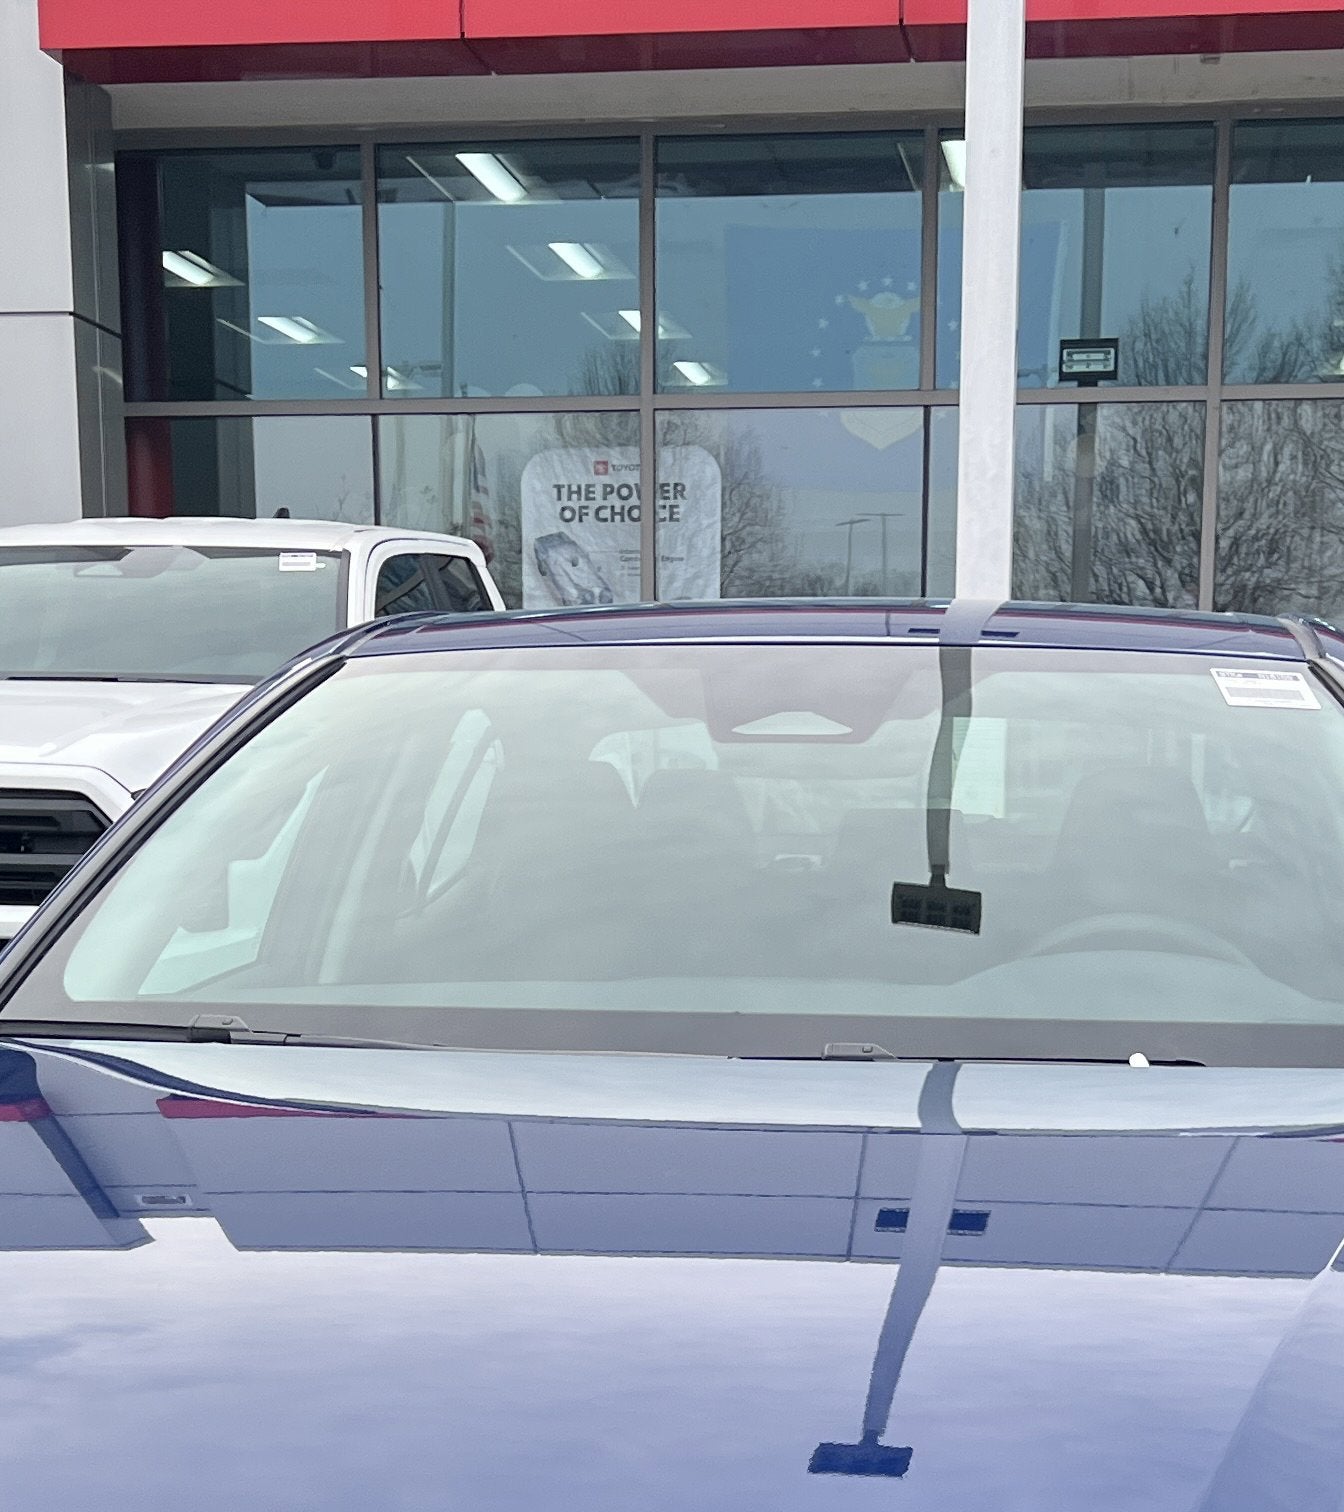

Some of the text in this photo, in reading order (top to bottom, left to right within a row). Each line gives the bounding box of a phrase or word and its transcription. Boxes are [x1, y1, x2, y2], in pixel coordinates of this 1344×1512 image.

[612, 463, 641, 472] TOYOT
[554, 484, 596, 501] THE
[559, 504, 681, 523] OF CHOCE
